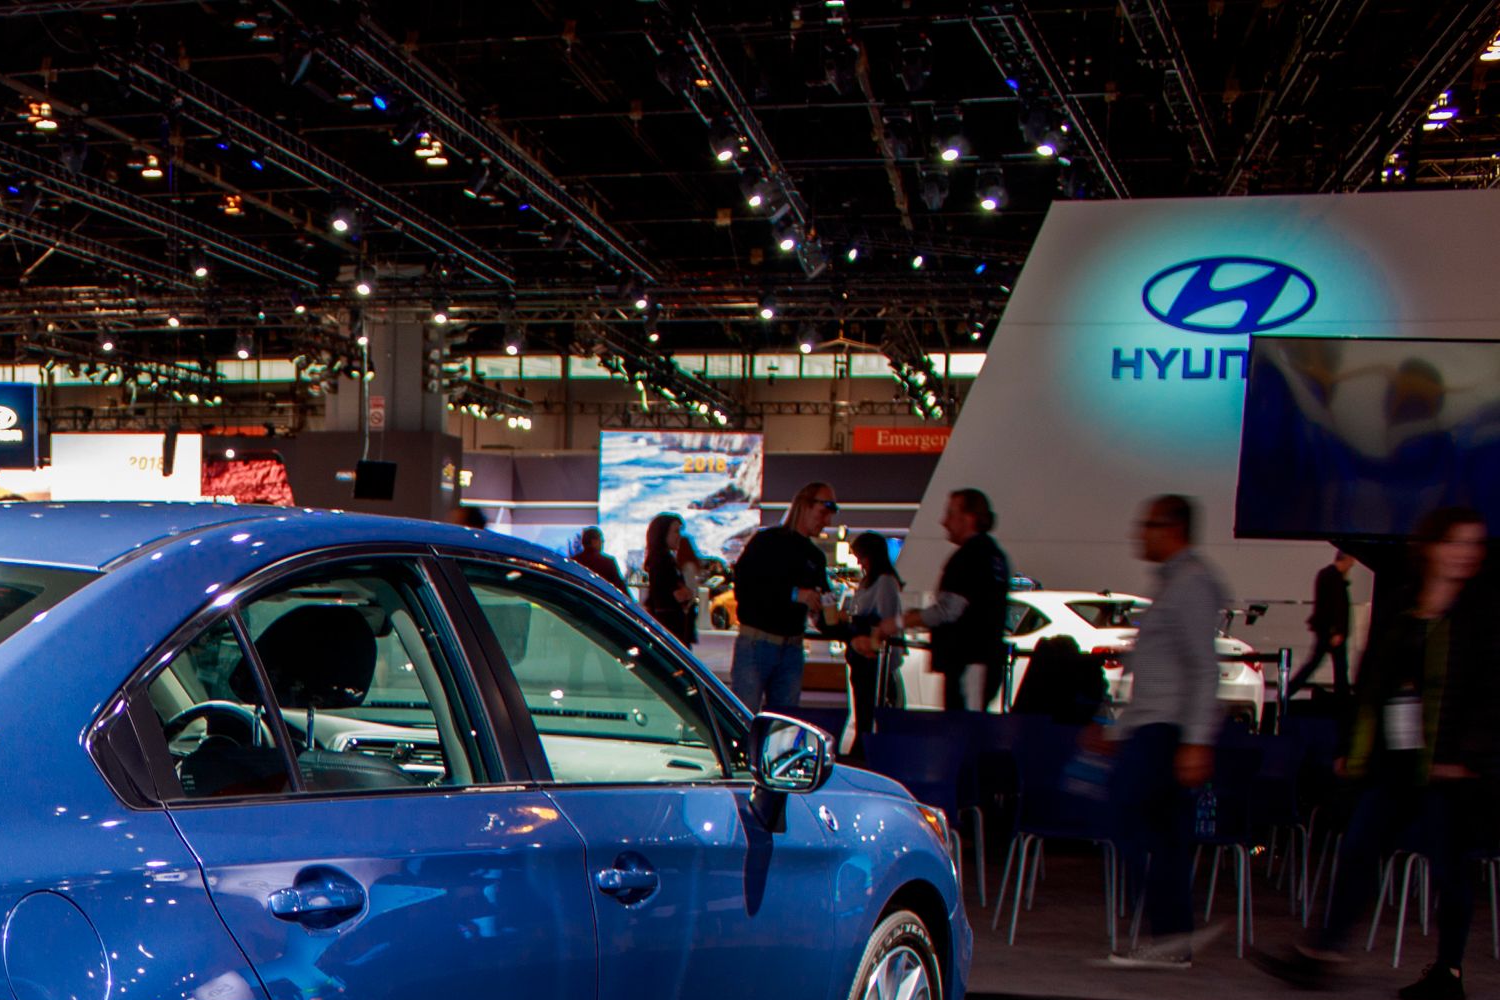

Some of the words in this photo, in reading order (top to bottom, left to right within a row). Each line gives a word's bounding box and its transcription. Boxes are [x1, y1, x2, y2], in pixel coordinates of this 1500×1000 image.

[1111, 347, 1250, 380] HYUN
[877, 430, 950, 451] Emergen
[684, 457, 727, 472] 2018
